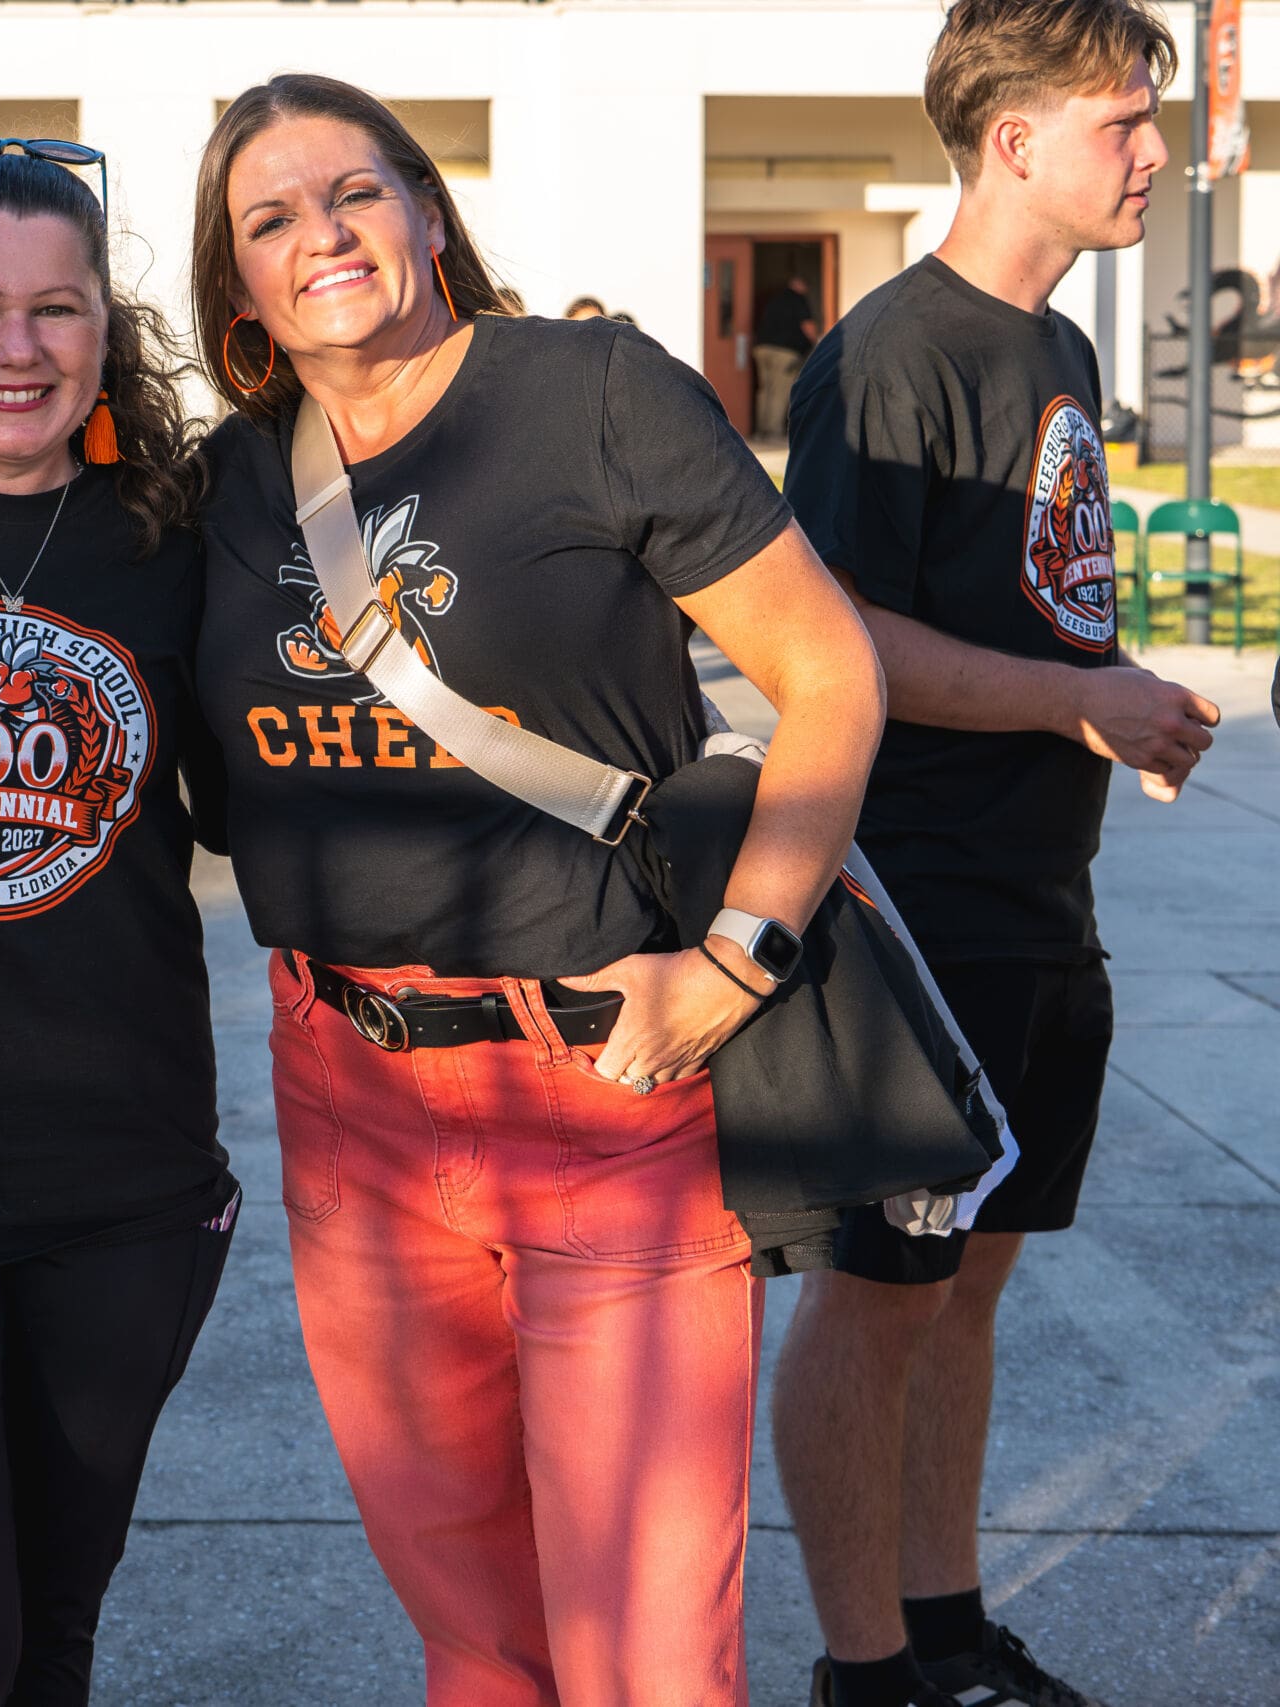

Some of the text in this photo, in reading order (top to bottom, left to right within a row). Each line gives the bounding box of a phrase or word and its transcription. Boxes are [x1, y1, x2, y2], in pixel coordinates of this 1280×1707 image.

[1069, 501, 1107, 557] 00
[1076, 584, 1098, 603] 1927
[65, 638, 142, 725] SCHOOL
[247, 705, 522, 769] CHE
[1, 828, 44, 852] 2027
[9, 857, 78, 900] FLORIDA
